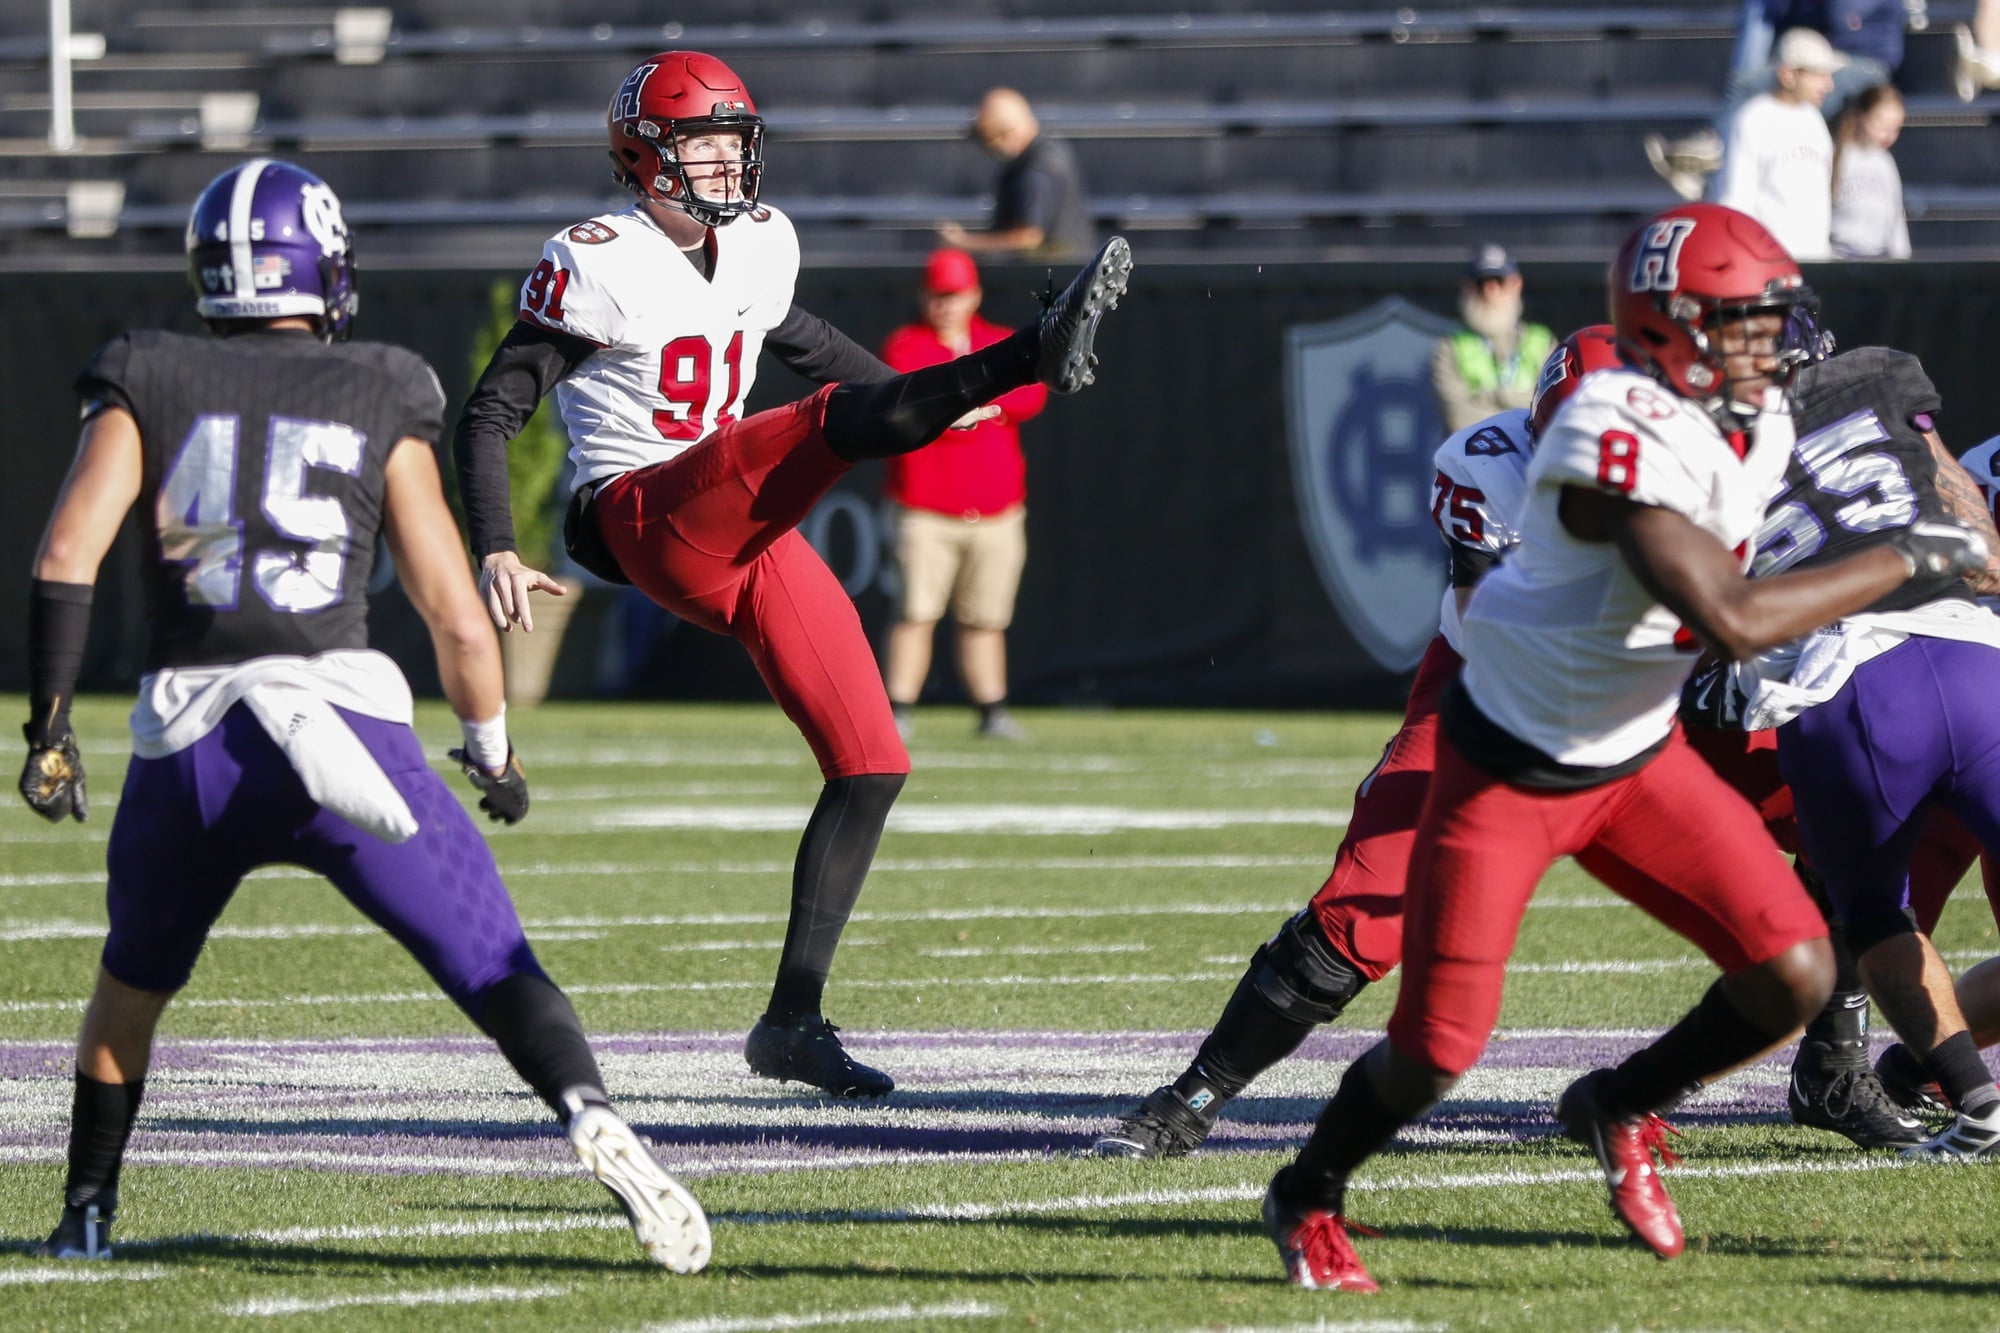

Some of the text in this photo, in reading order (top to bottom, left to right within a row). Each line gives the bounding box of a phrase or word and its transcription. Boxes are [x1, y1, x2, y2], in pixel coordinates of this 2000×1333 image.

[612, 64, 659, 122] H
[527, 258, 571, 321] 91
[1630, 217, 1697, 293] H
[652, 330, 744, 441] 91
[1597, 428, 1640, 498] 8
[155, 412, 368, 614] 45
[1431, 468, 1486, 543] 75
